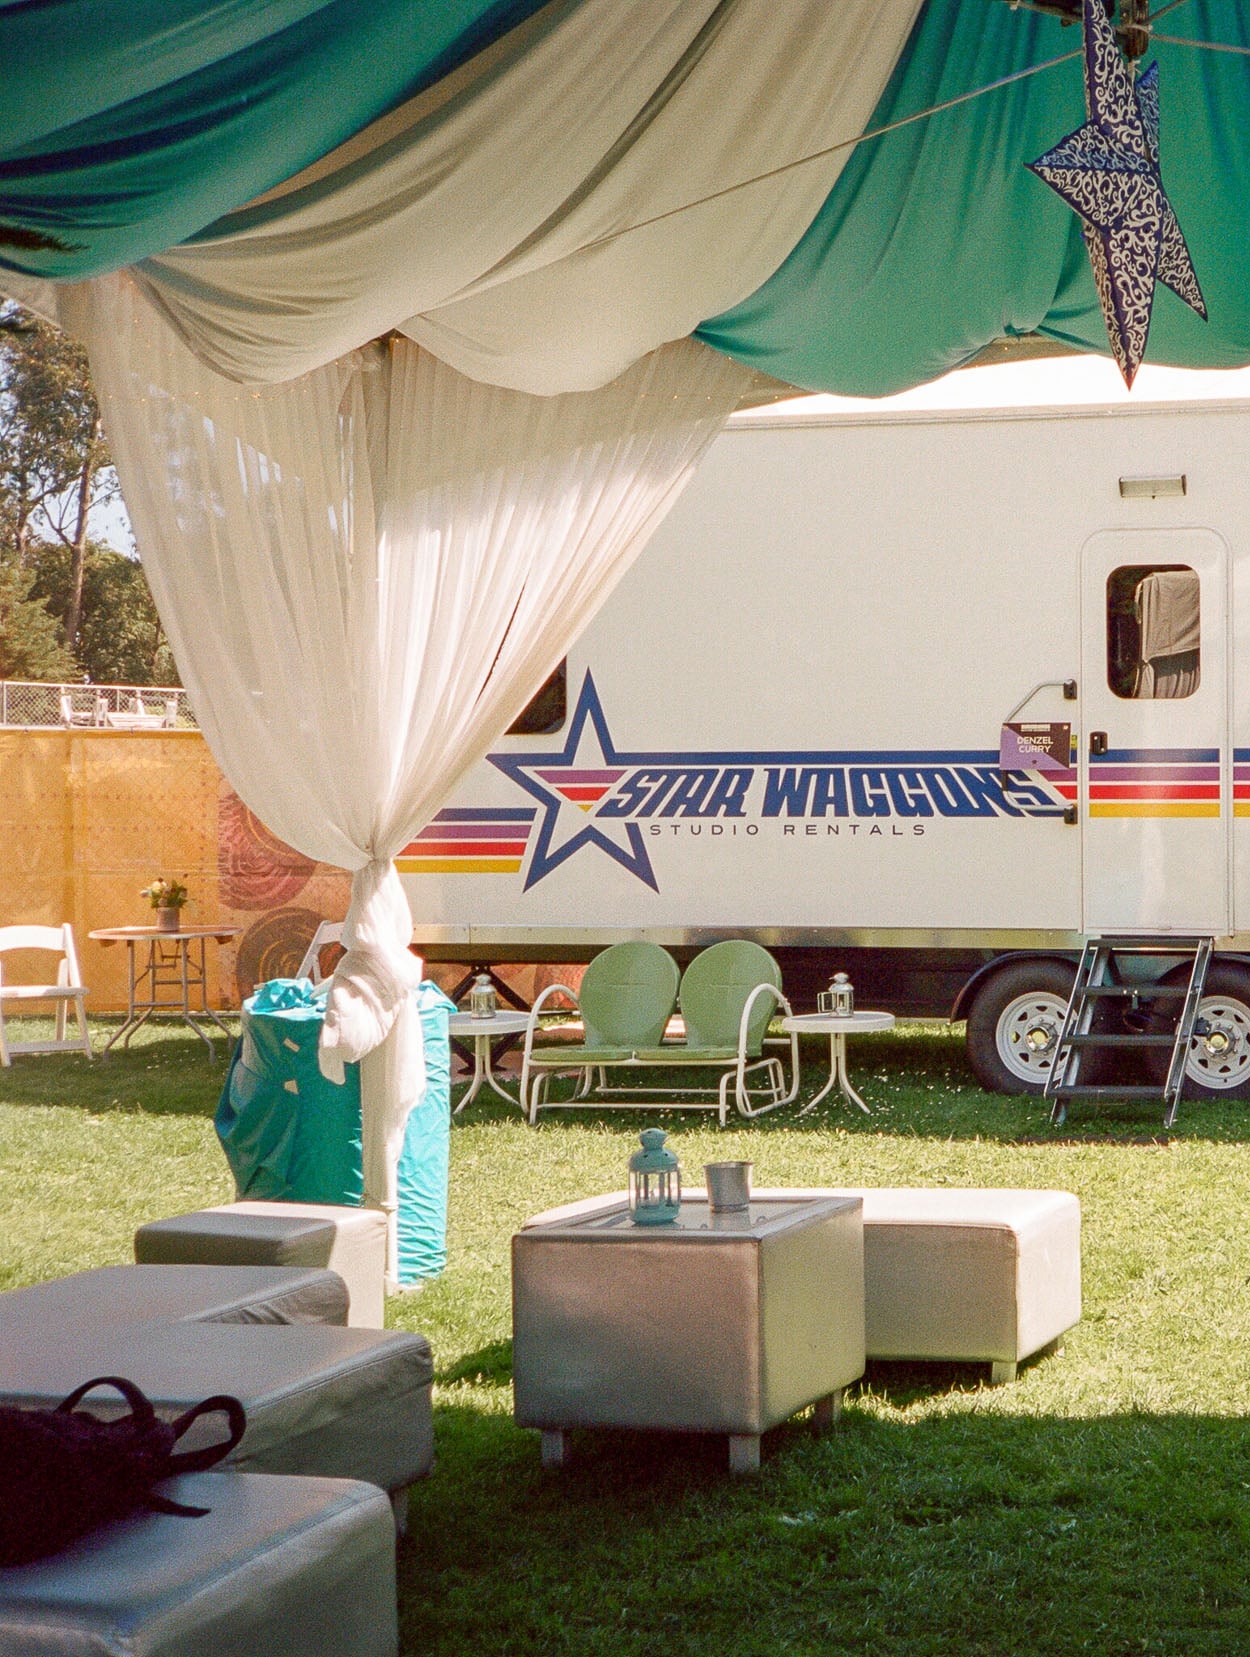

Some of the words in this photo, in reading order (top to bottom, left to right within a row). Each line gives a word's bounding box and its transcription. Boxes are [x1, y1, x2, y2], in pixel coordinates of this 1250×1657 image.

[1017, 736, 1054, 745] DENZEL
[1018, 745, 1052, 753] CURRY
[595, 768, 755, 818] STAR
[761, 767, 1065, 818] WAGGONS
[649, 824, 759, 836] STUDIO
[783, 824, 925, 836] RENTALS
